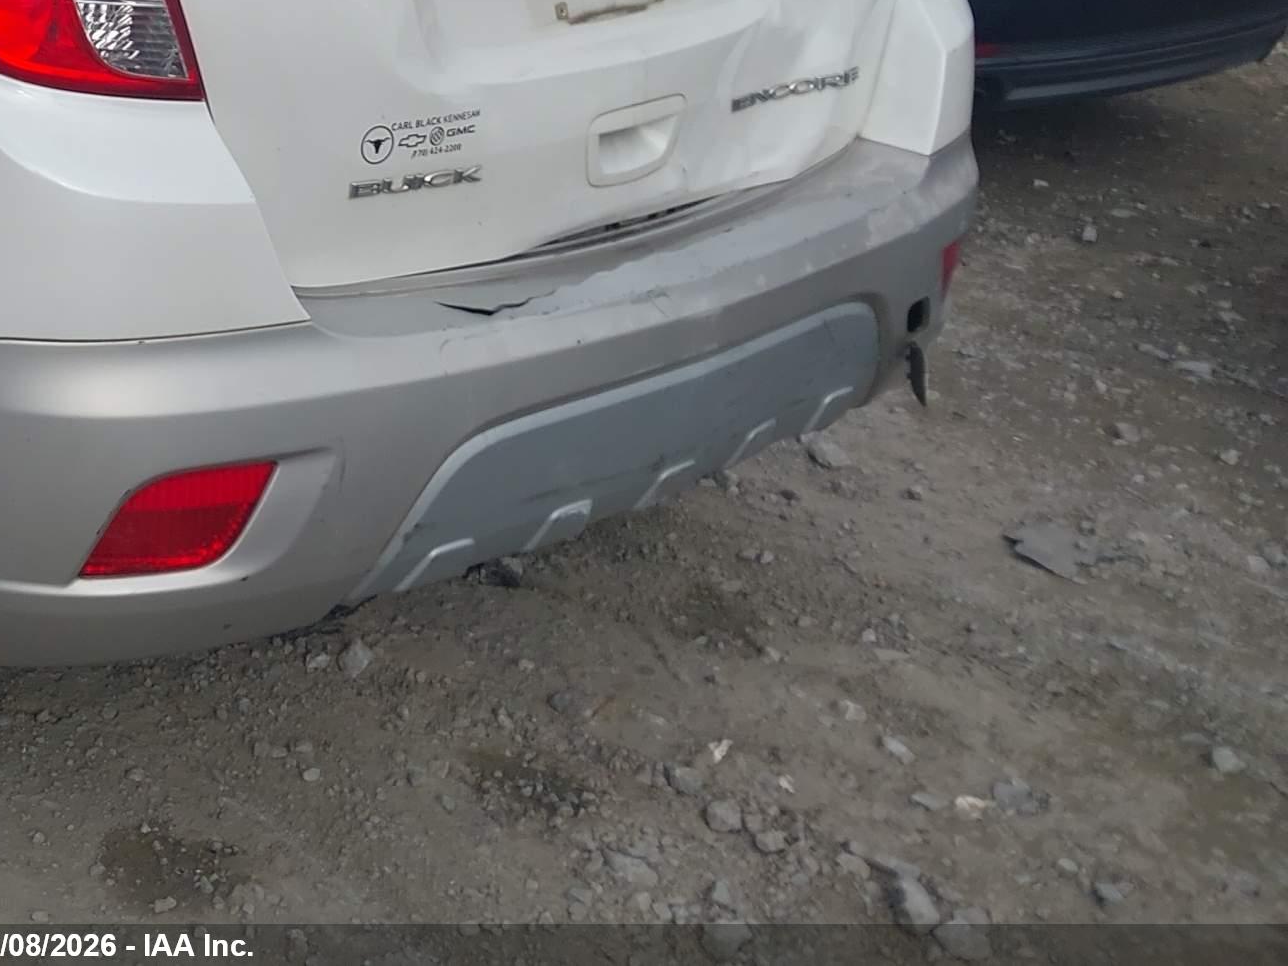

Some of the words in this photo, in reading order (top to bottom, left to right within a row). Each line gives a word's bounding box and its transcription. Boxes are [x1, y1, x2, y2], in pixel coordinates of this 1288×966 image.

[391, 121, 413, 131] CARL
[415, 116, 442, 128] BLACK
[446, 124, 476, 137] GMC
[348, 165, 482, 200] BUICK
